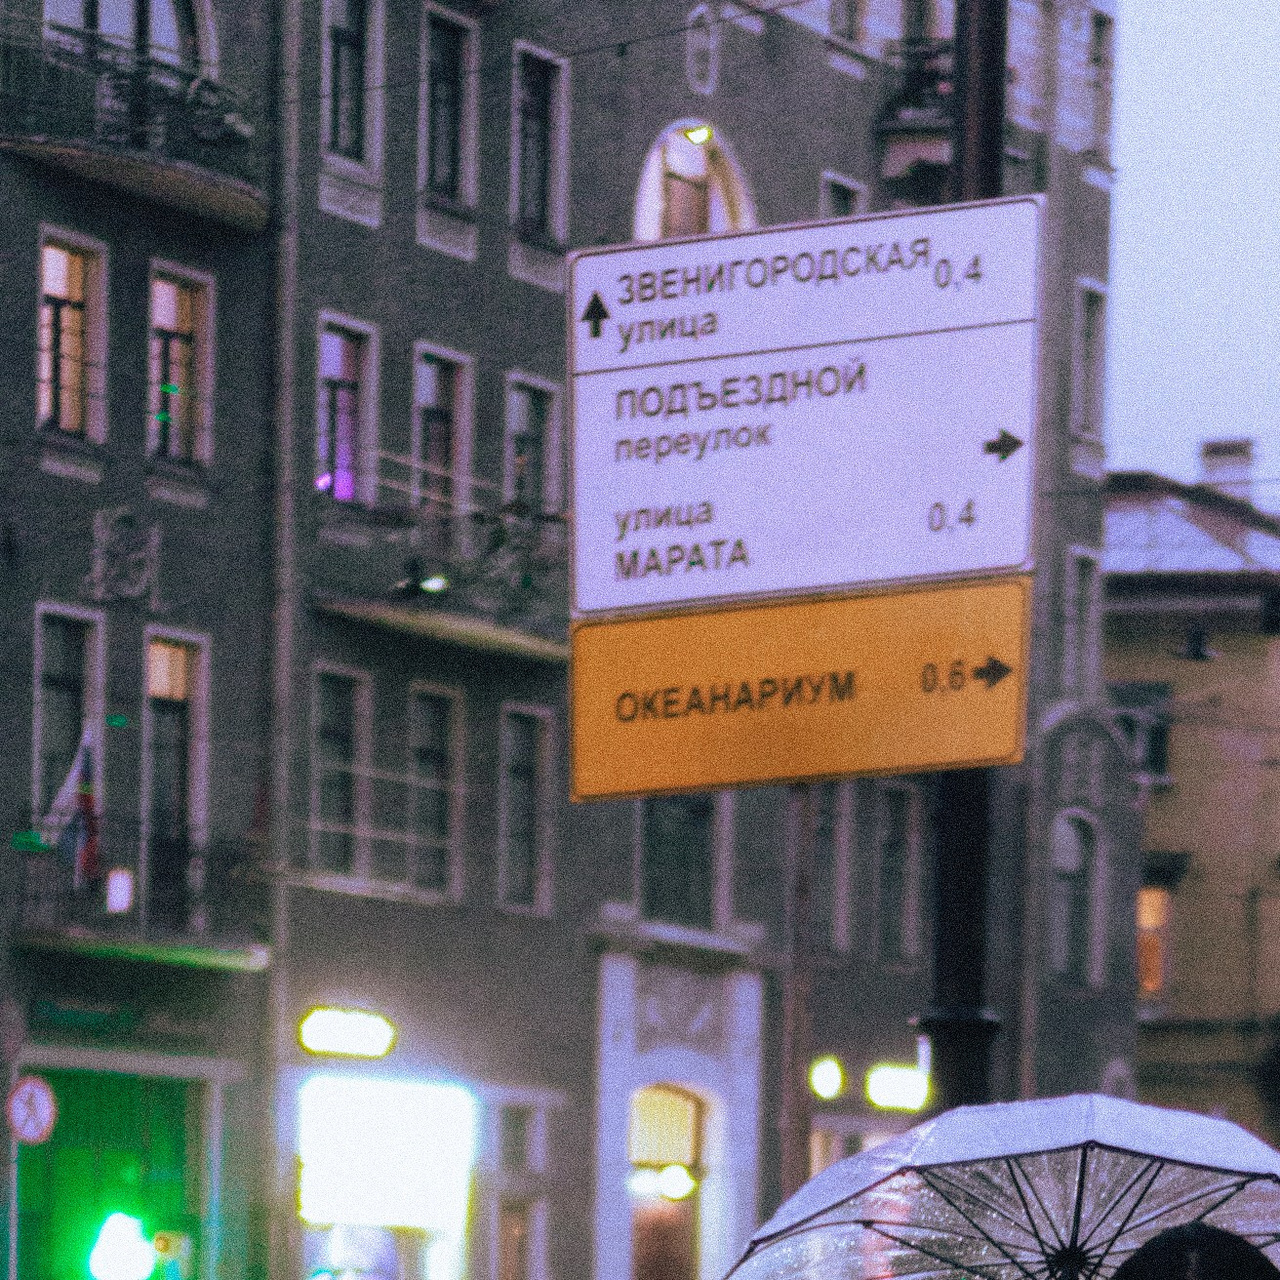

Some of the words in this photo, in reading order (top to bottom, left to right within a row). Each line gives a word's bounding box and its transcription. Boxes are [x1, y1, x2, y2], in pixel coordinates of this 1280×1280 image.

[618, 238, 930, 304] ЗВЕНИГОРОДСКАЯ
[618, 311, 719, 353] улица
[615, 358, 868, 419] ПОДЪЕЗДНОЙ
[615, 423, 772, 463] переулок
[614, 500, 714, 540] улица
[614, 539, 749, 581] МАРАТА
[615, 670, 856, 723] ОКЕАНАРИУМ
